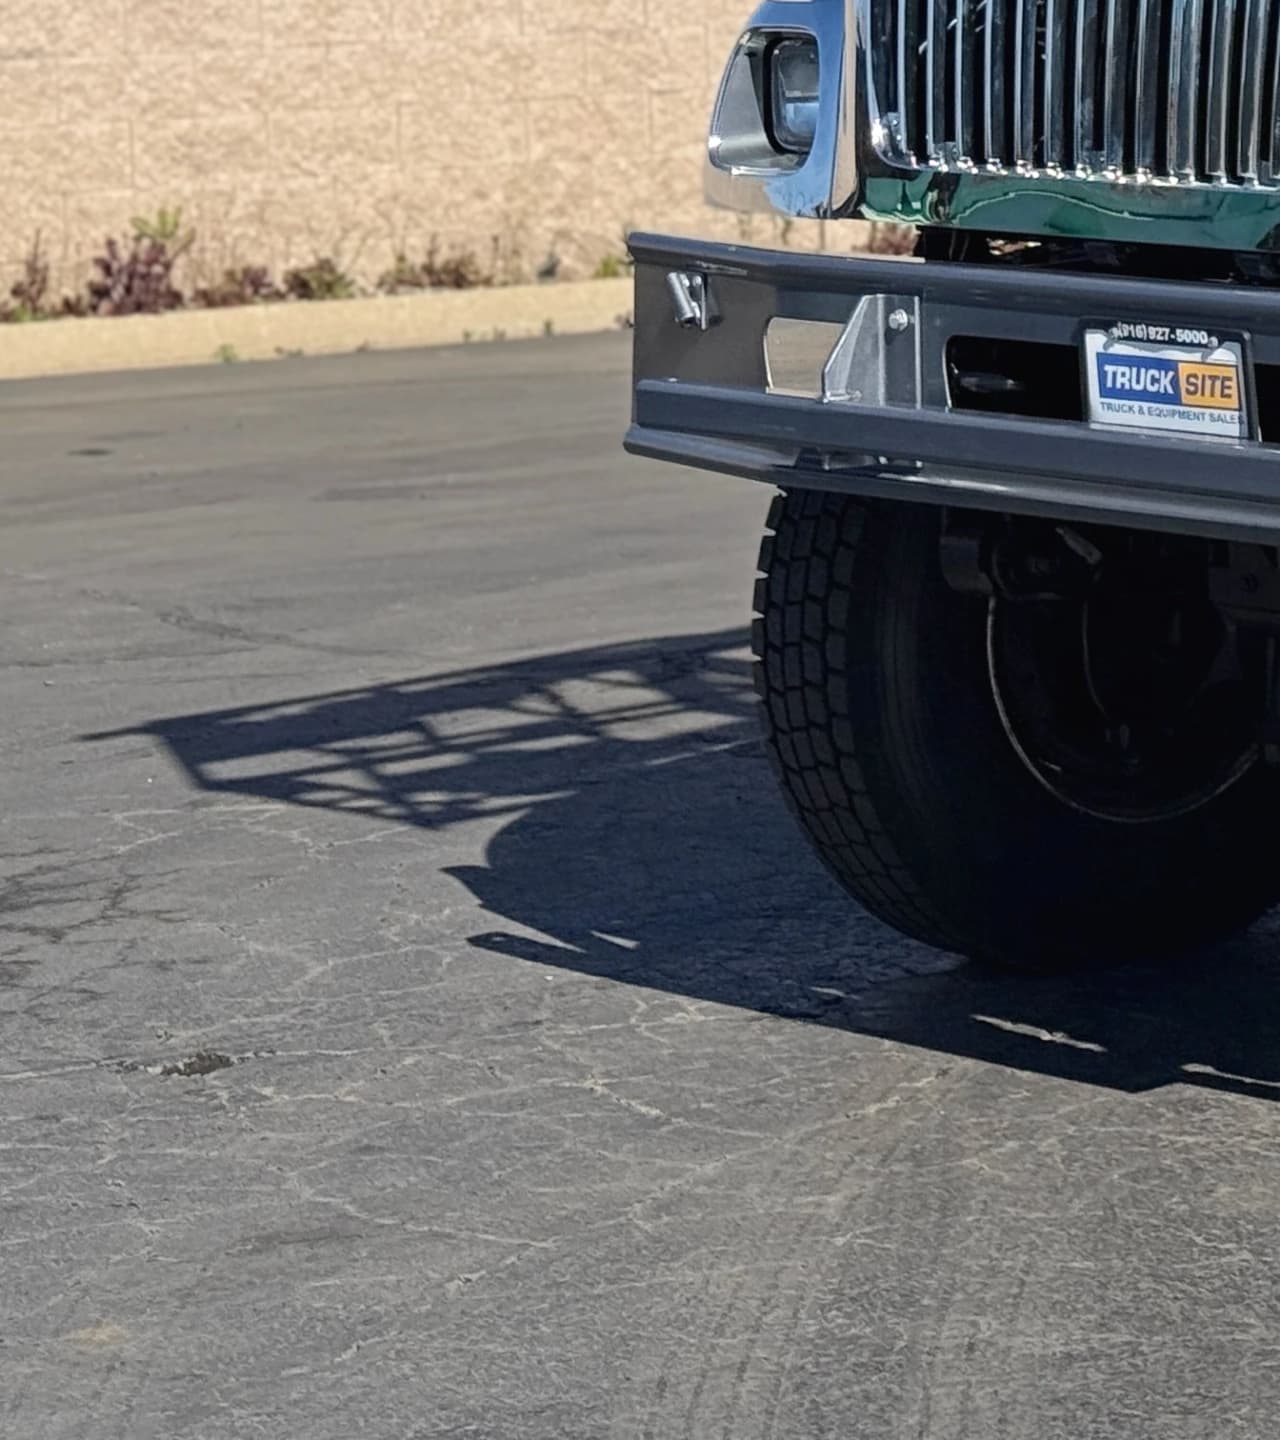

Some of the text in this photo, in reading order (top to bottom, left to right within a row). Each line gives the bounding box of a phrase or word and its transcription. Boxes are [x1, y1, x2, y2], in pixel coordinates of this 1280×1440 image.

[1103, 364, 1233, 399] TRUCK SITE
[1100, 401, 1245, 425] TRUCK & EQUIPMENT SALES
